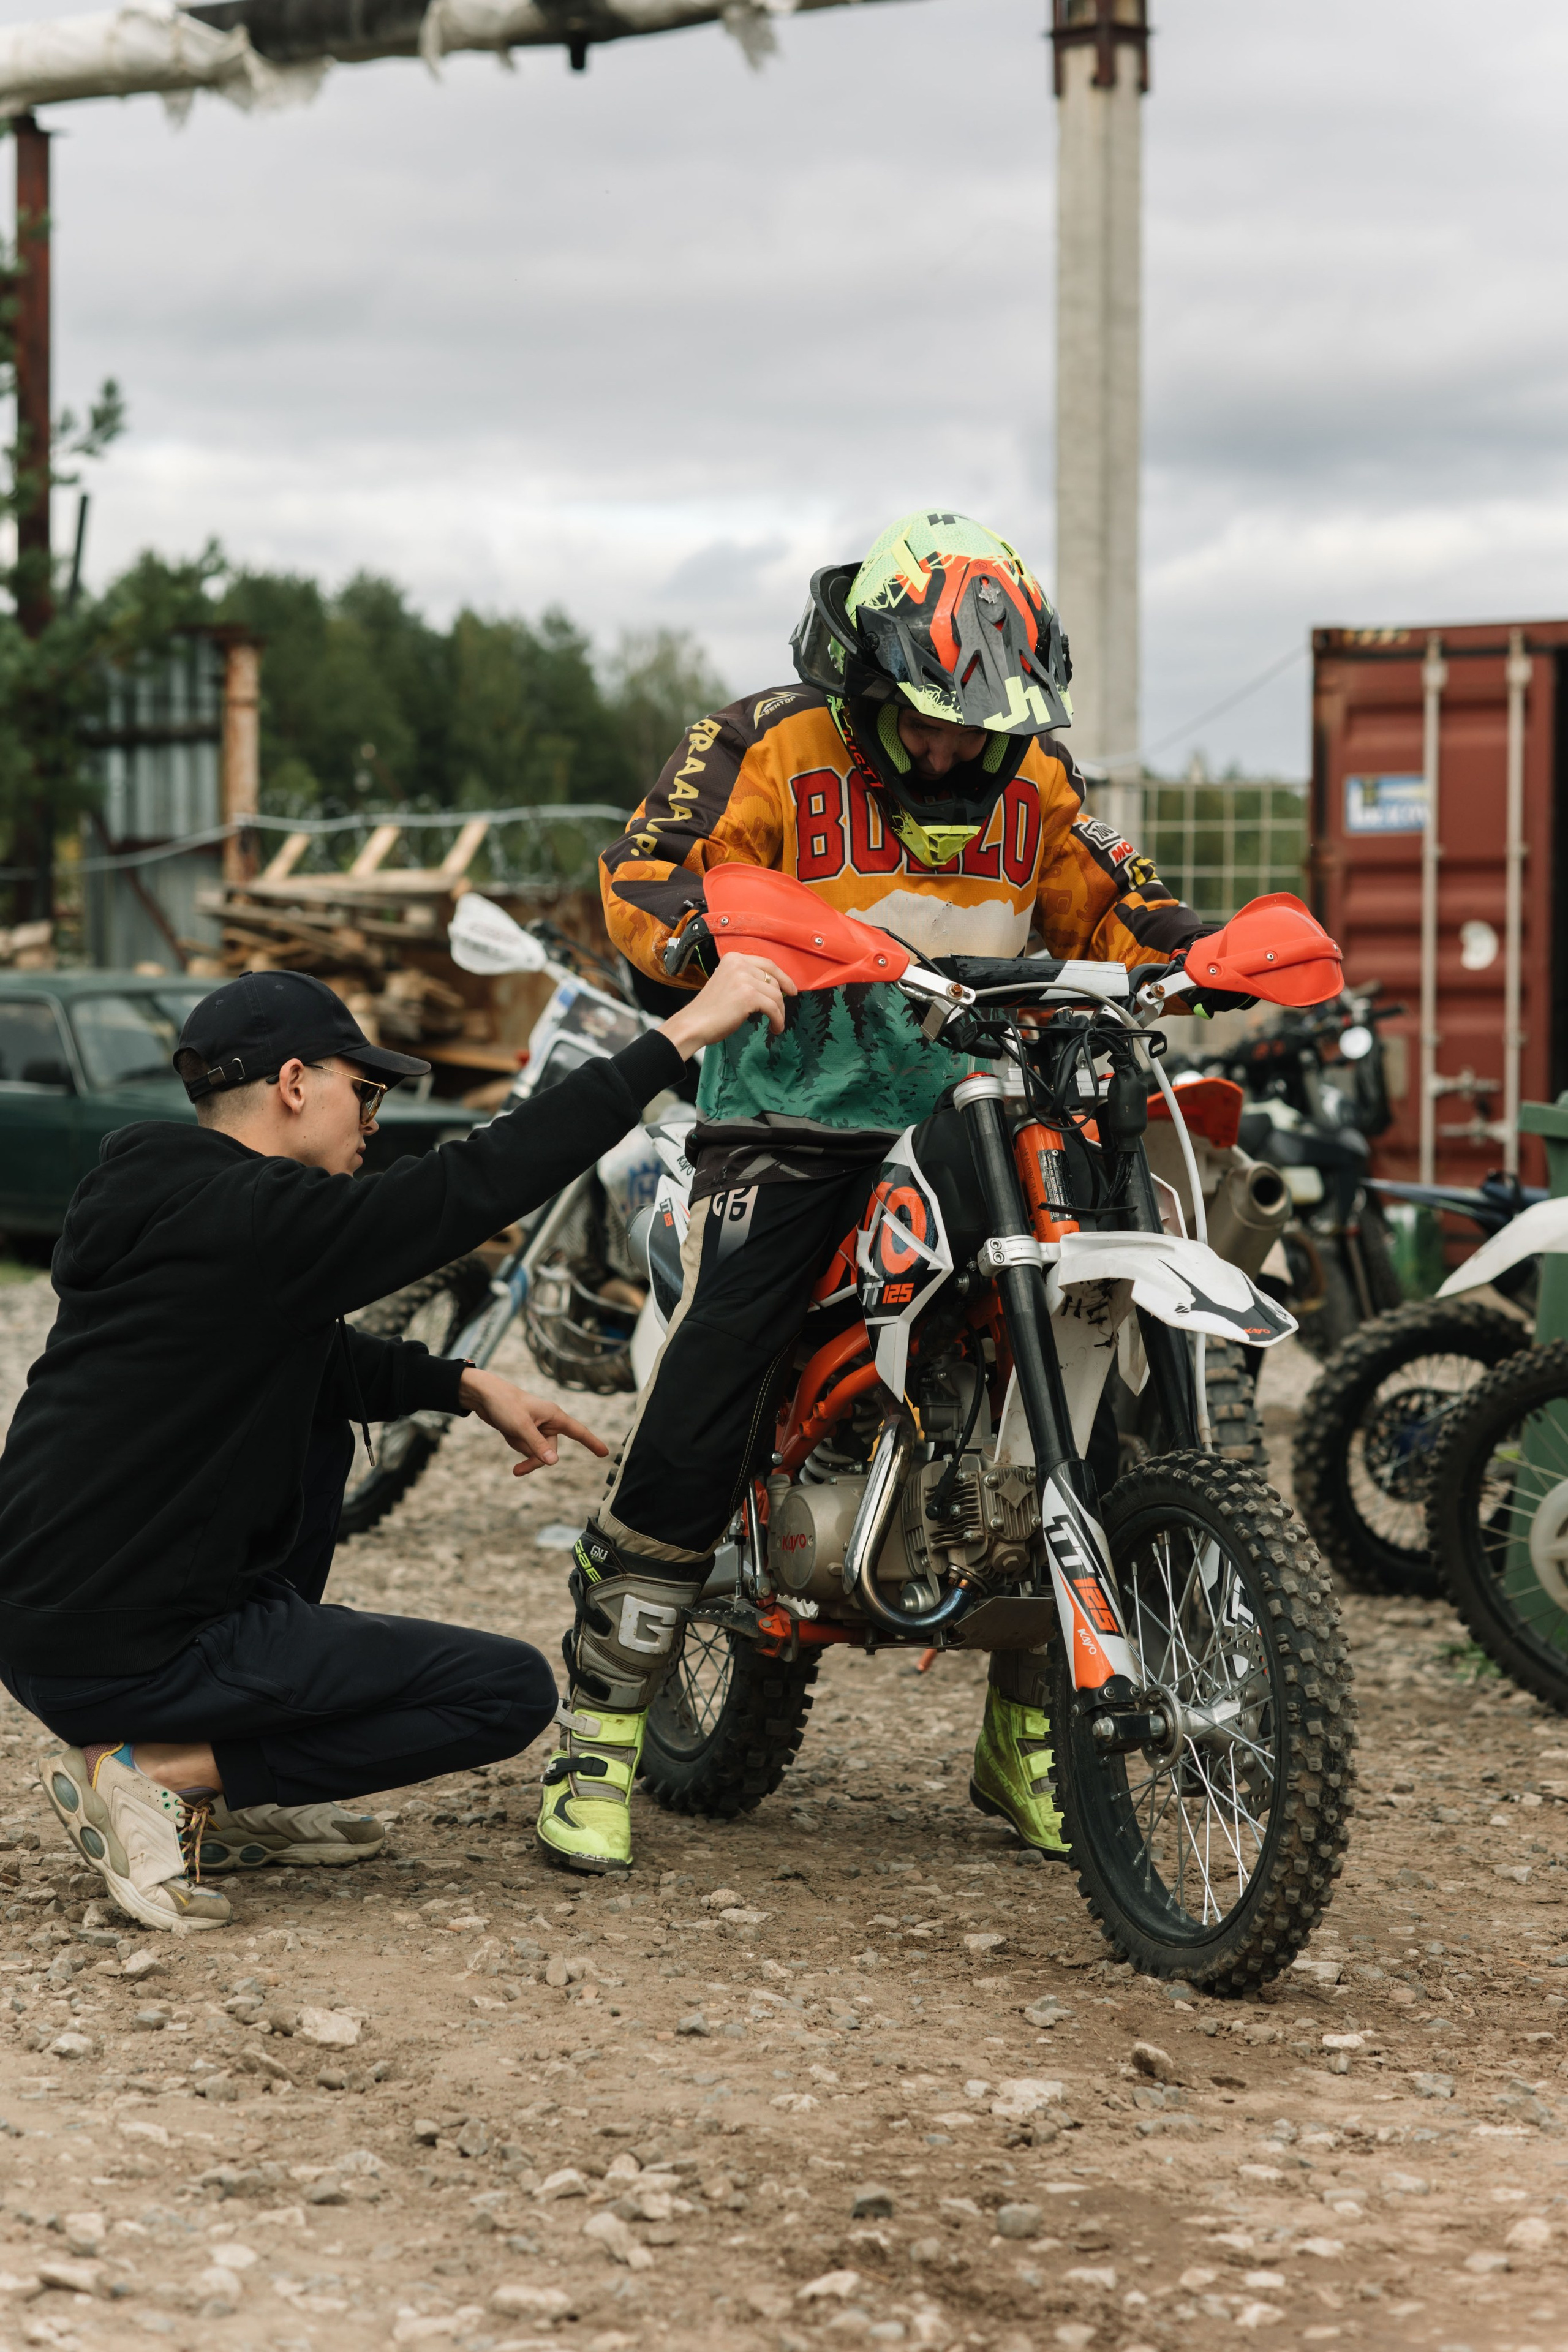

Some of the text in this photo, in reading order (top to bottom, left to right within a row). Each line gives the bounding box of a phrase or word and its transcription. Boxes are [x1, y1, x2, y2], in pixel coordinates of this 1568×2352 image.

[782, 1529, 807, 1553] KAYO
[618, 1594, 677, 1654] G
[1077, 1628, 1097, 1656] KAYO
